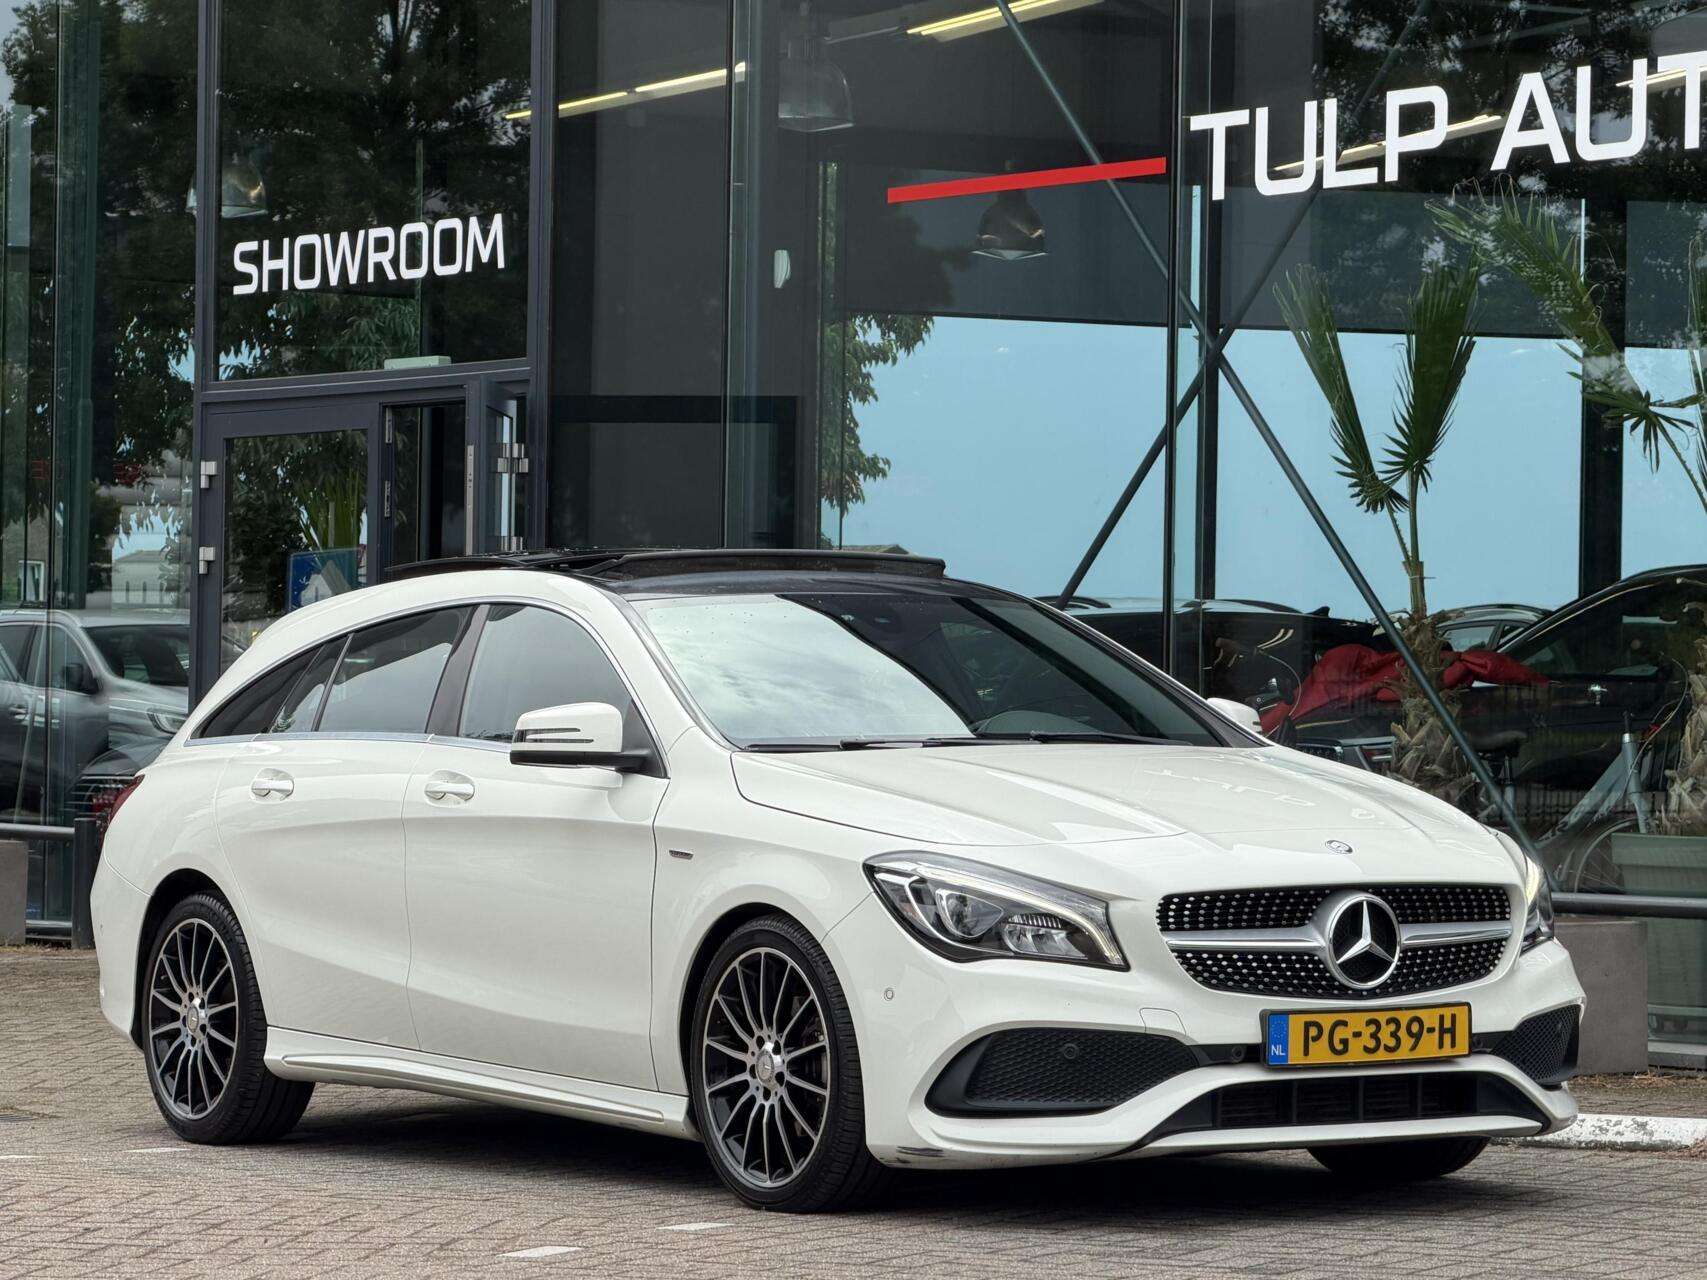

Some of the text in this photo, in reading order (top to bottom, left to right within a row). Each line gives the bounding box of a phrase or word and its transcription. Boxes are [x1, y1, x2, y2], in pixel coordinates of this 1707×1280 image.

[1190, 50, 1707, 201] TULP AUT
[233, 213, 505, 295] SHOWROOM
[1271, 1044, 1286, 1056] NL
[1303, 1013, 1457, 1057] PG-339-H
